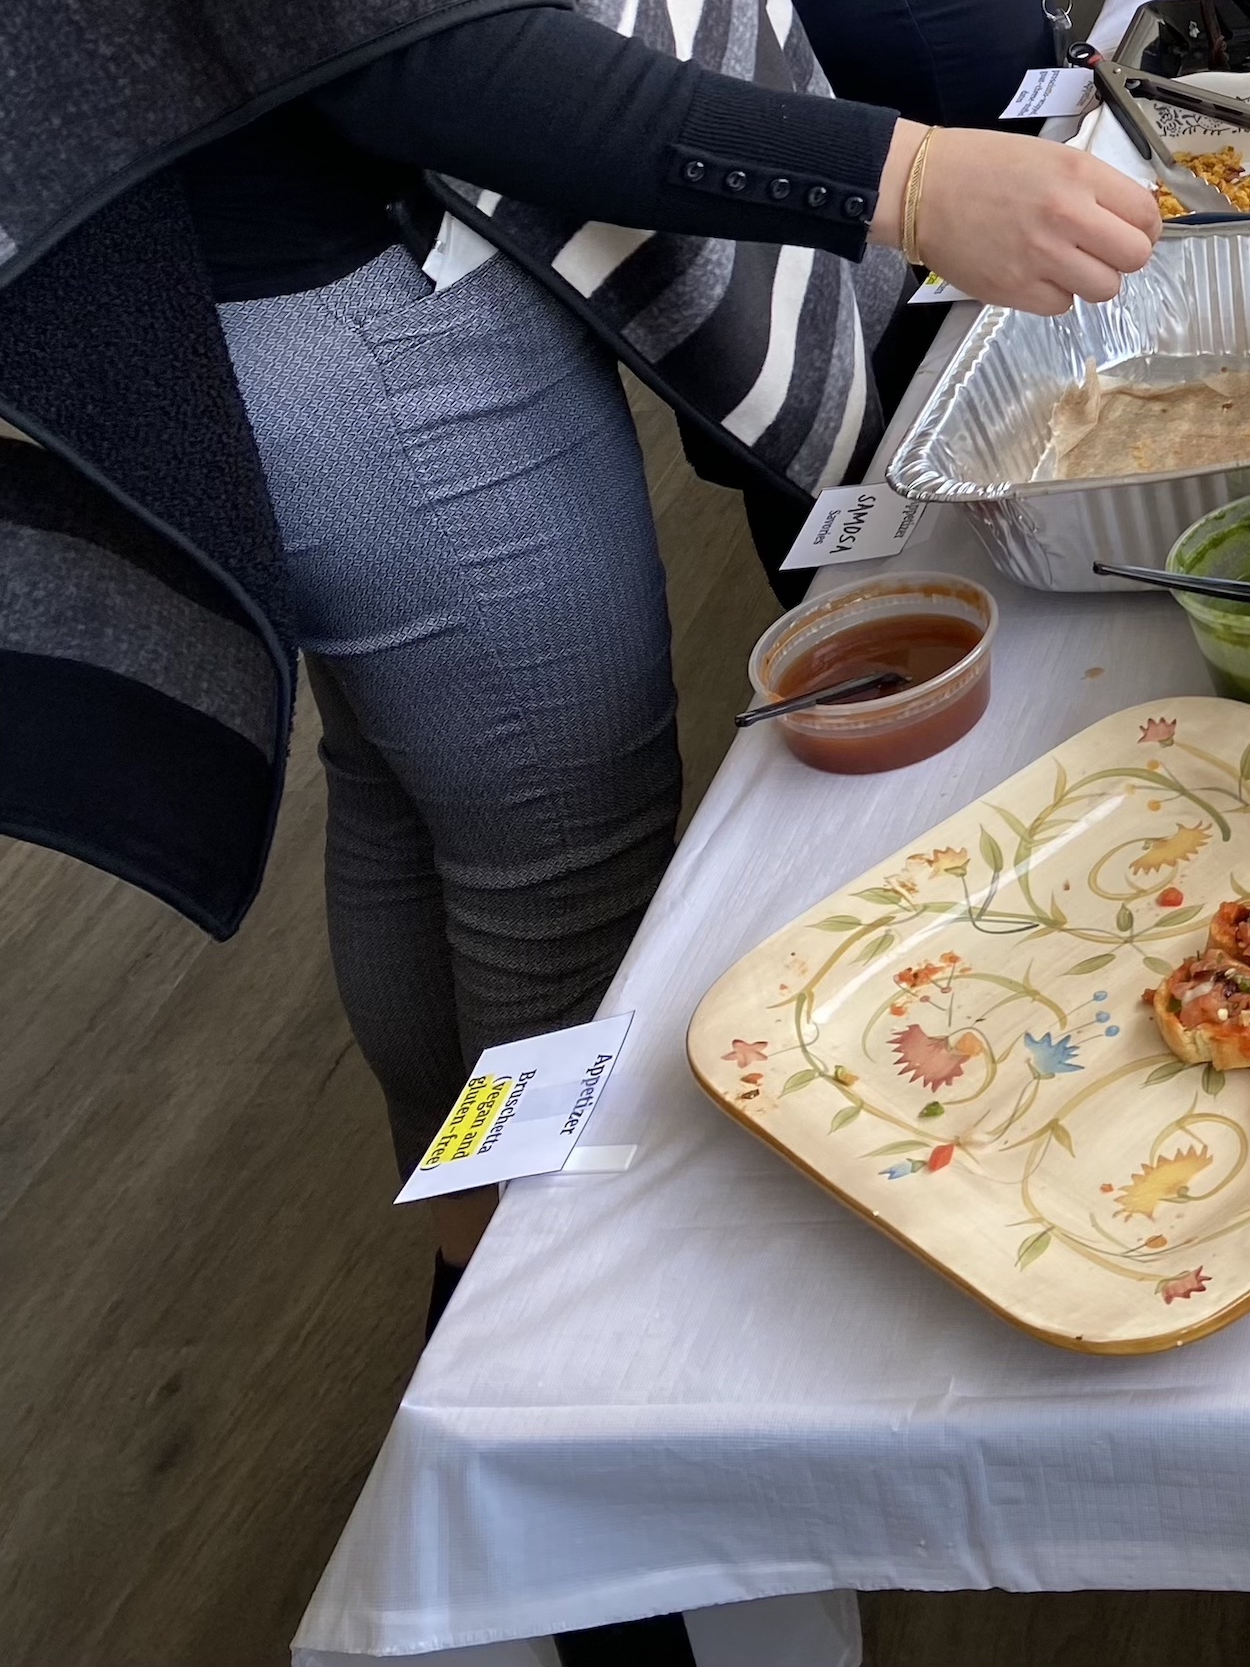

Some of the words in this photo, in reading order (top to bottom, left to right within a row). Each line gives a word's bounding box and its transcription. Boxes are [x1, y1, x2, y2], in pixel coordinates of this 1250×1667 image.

[813, 509, 842, 545] Savories
[829, 494, 876, 554] SAMOSA
[419, 1075, 488, 1172] gluten-free)
[470, 1075, 513, 1130] (vegan
[476, 1068, 538, 1155] Bruschetta
[560, 1053, 613, 1136] Appetizer
[450, 1131, 478, 1161] and
